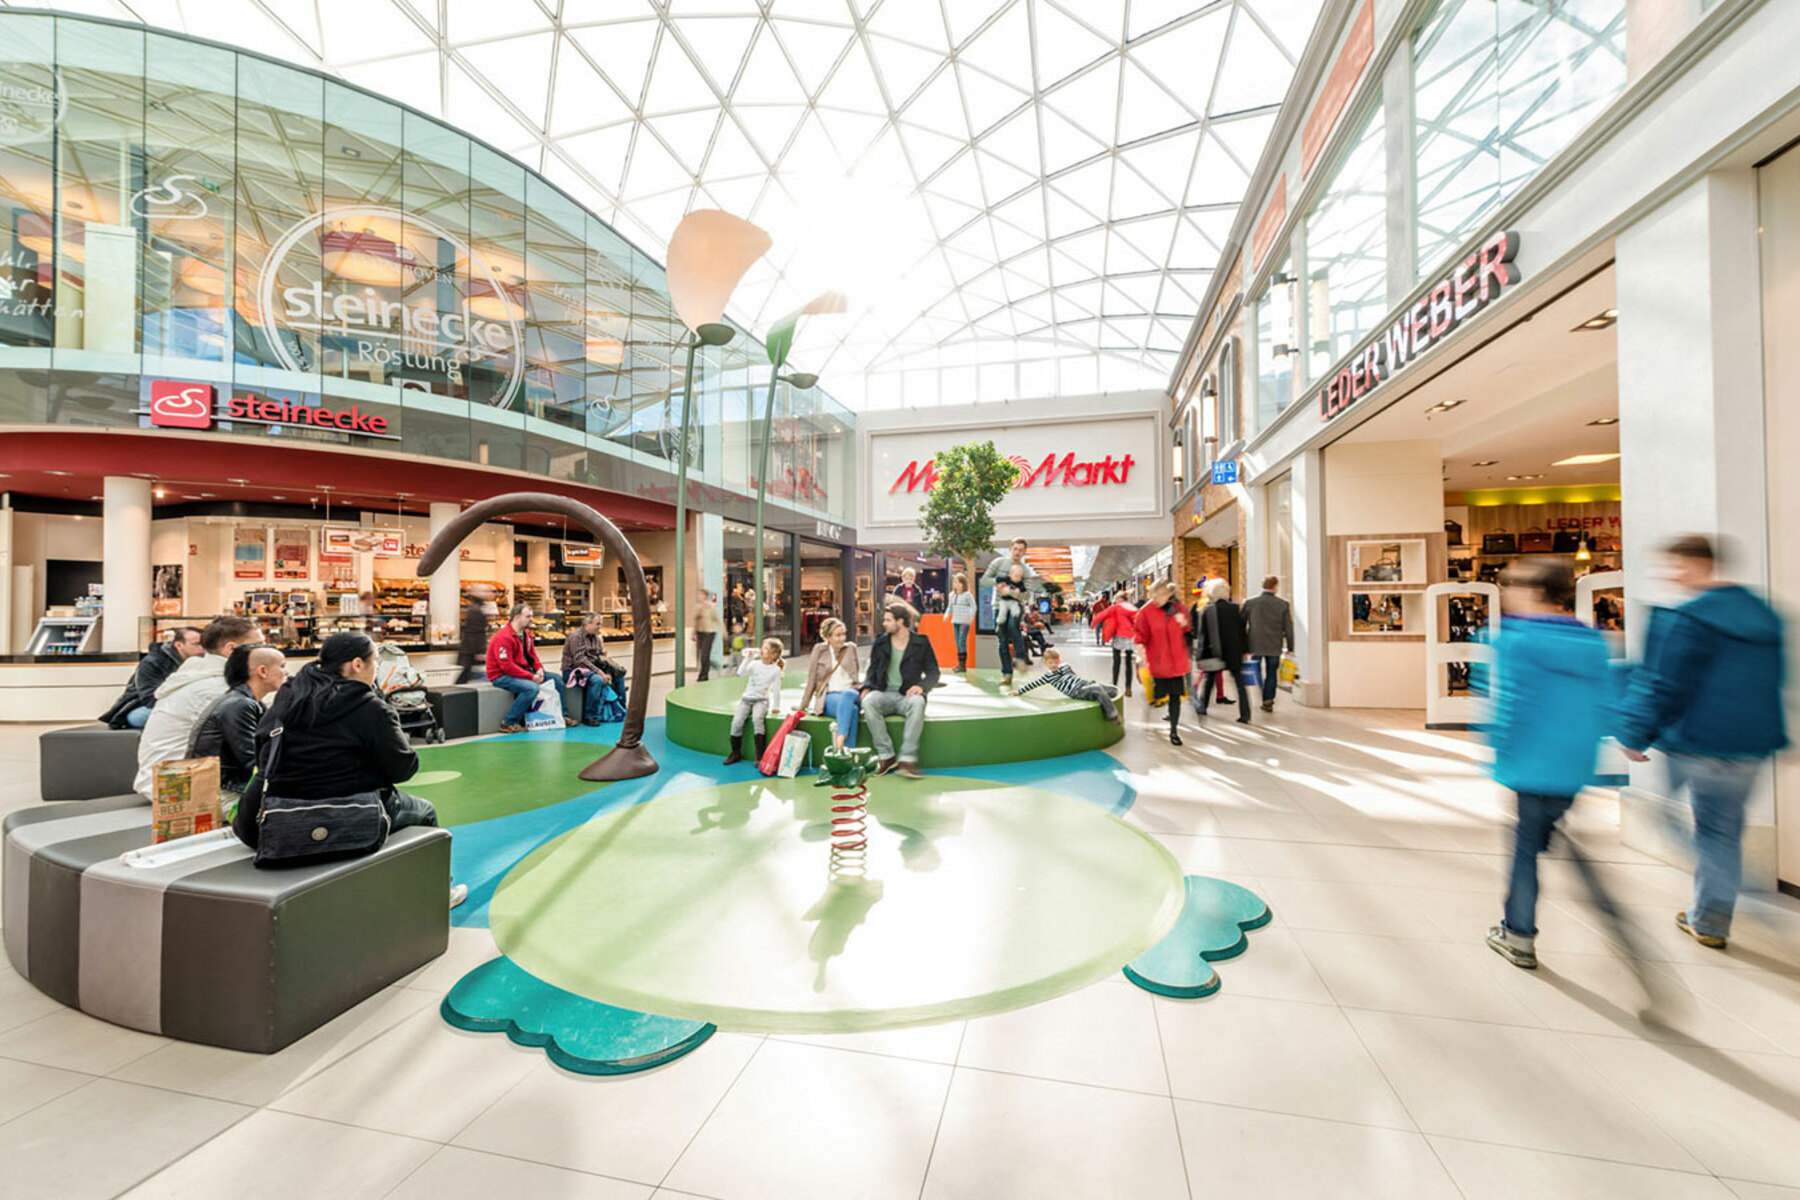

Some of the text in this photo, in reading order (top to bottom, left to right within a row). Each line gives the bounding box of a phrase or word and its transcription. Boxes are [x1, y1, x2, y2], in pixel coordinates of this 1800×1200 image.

[283, 280, 508, 348] steinecke
[1319, 231, 1520, 423] LEDER WEBER
[357, 340, 462, 381] Röstung
[227, 394, 388, 434] steinecke
[1022, 452, 1136, 488] Markt
[1546, 516, 1604, 530] LEDER
